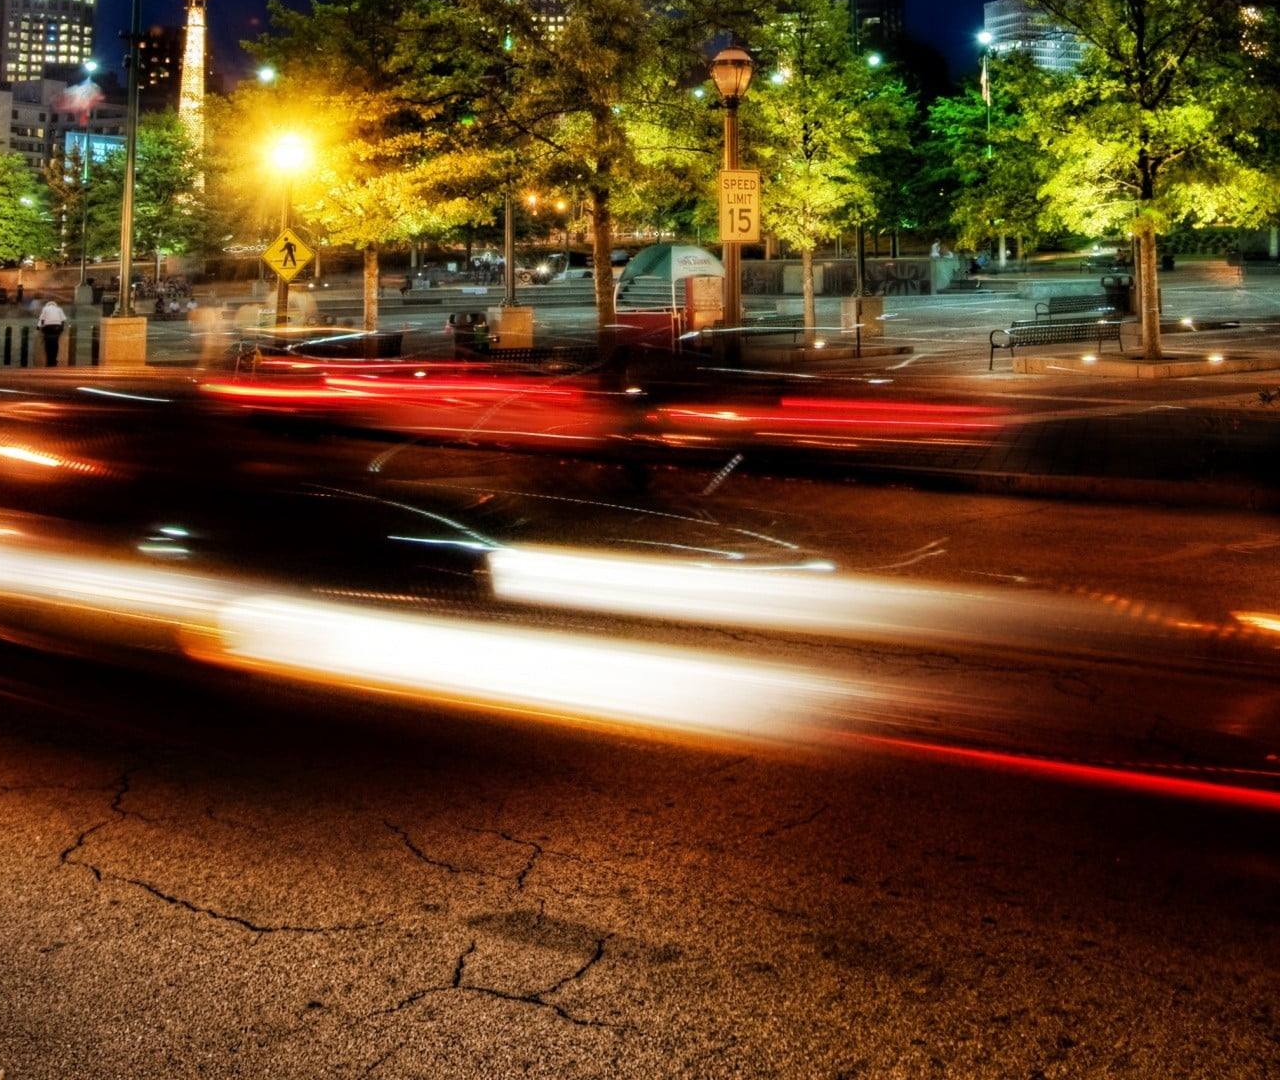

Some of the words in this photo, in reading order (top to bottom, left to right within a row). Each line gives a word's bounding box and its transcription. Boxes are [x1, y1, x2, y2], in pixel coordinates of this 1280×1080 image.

[723, 179, 756, 190] SPEED
[727, 193, 753, 205] LIMIT
[728, 208, 752, 234] 15
